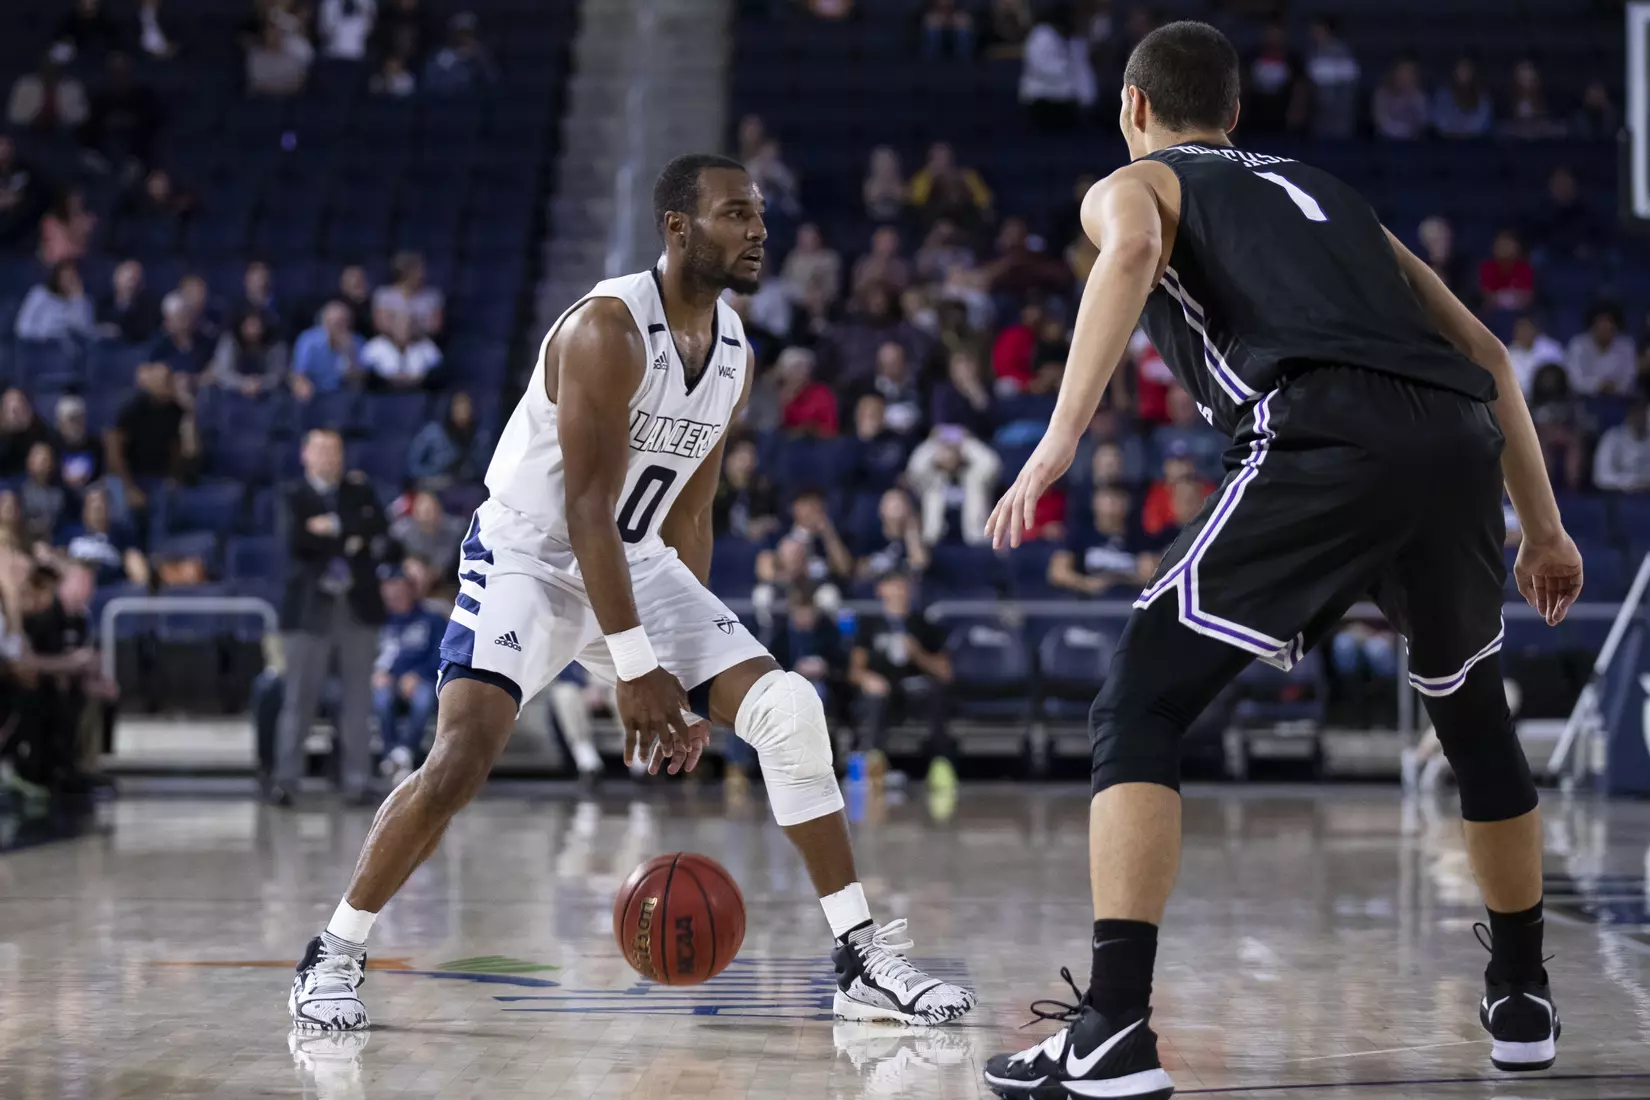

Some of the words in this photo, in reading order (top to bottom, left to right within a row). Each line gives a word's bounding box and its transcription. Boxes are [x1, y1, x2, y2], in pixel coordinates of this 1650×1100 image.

[1252, 171, 1330, 222] 1
[717, 364, 737, 380] WAC
[617, 464, 678, 544] 0
[675, 915, 696, 975] NCAA
